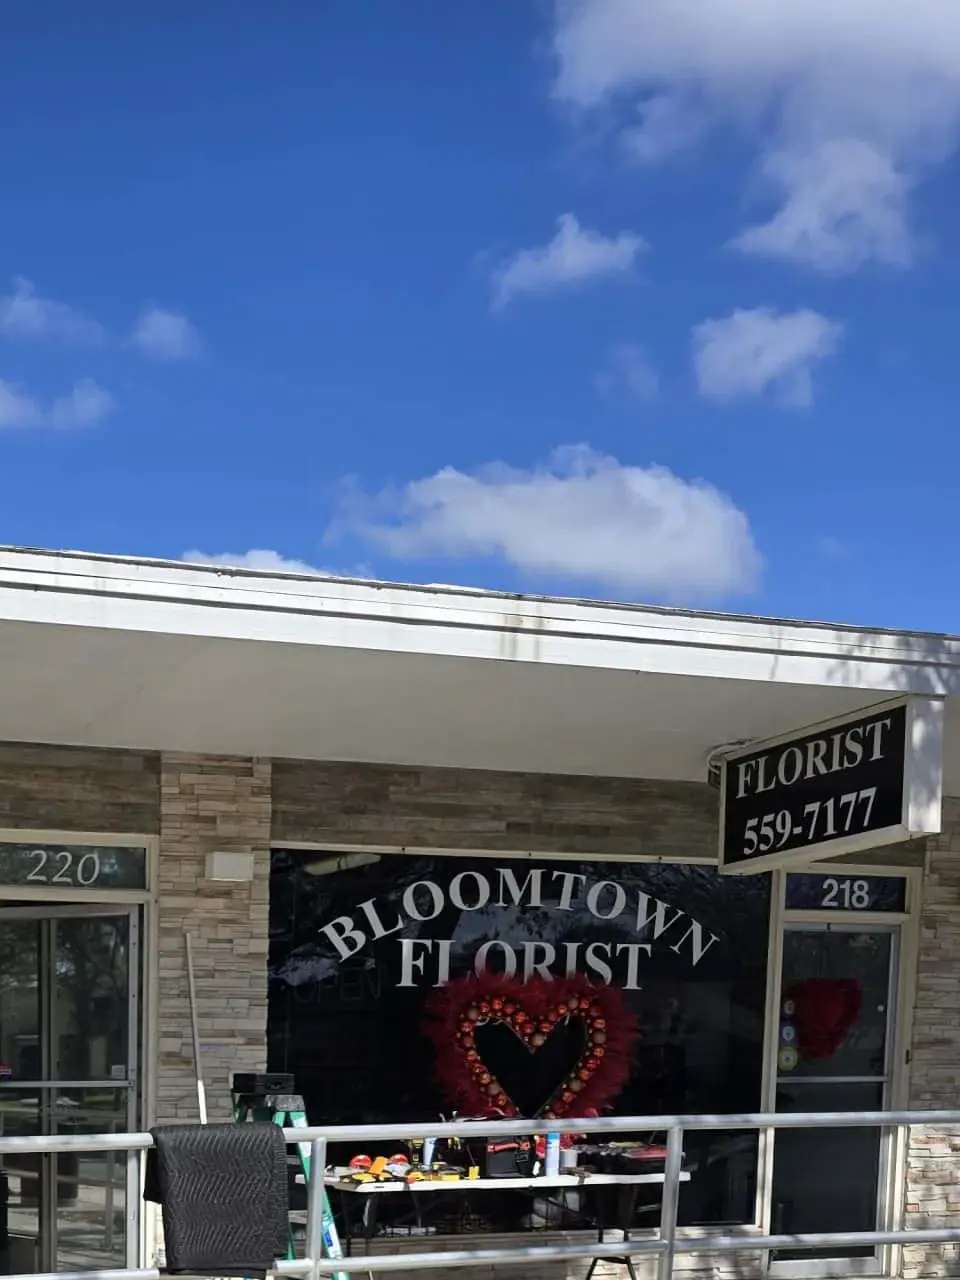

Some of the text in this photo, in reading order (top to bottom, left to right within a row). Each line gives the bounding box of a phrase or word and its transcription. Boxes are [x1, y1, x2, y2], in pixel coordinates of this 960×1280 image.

[736, 718, 892, 799] FLORIST
[743, 786, 877, 855] 559-7177
[26, 849, 100, 885] 220
[821, 878, 870, 909] 218
[318, 868, 721, 967] BLOOMTOWN
[395, 938, 652, 990] FLORIST
